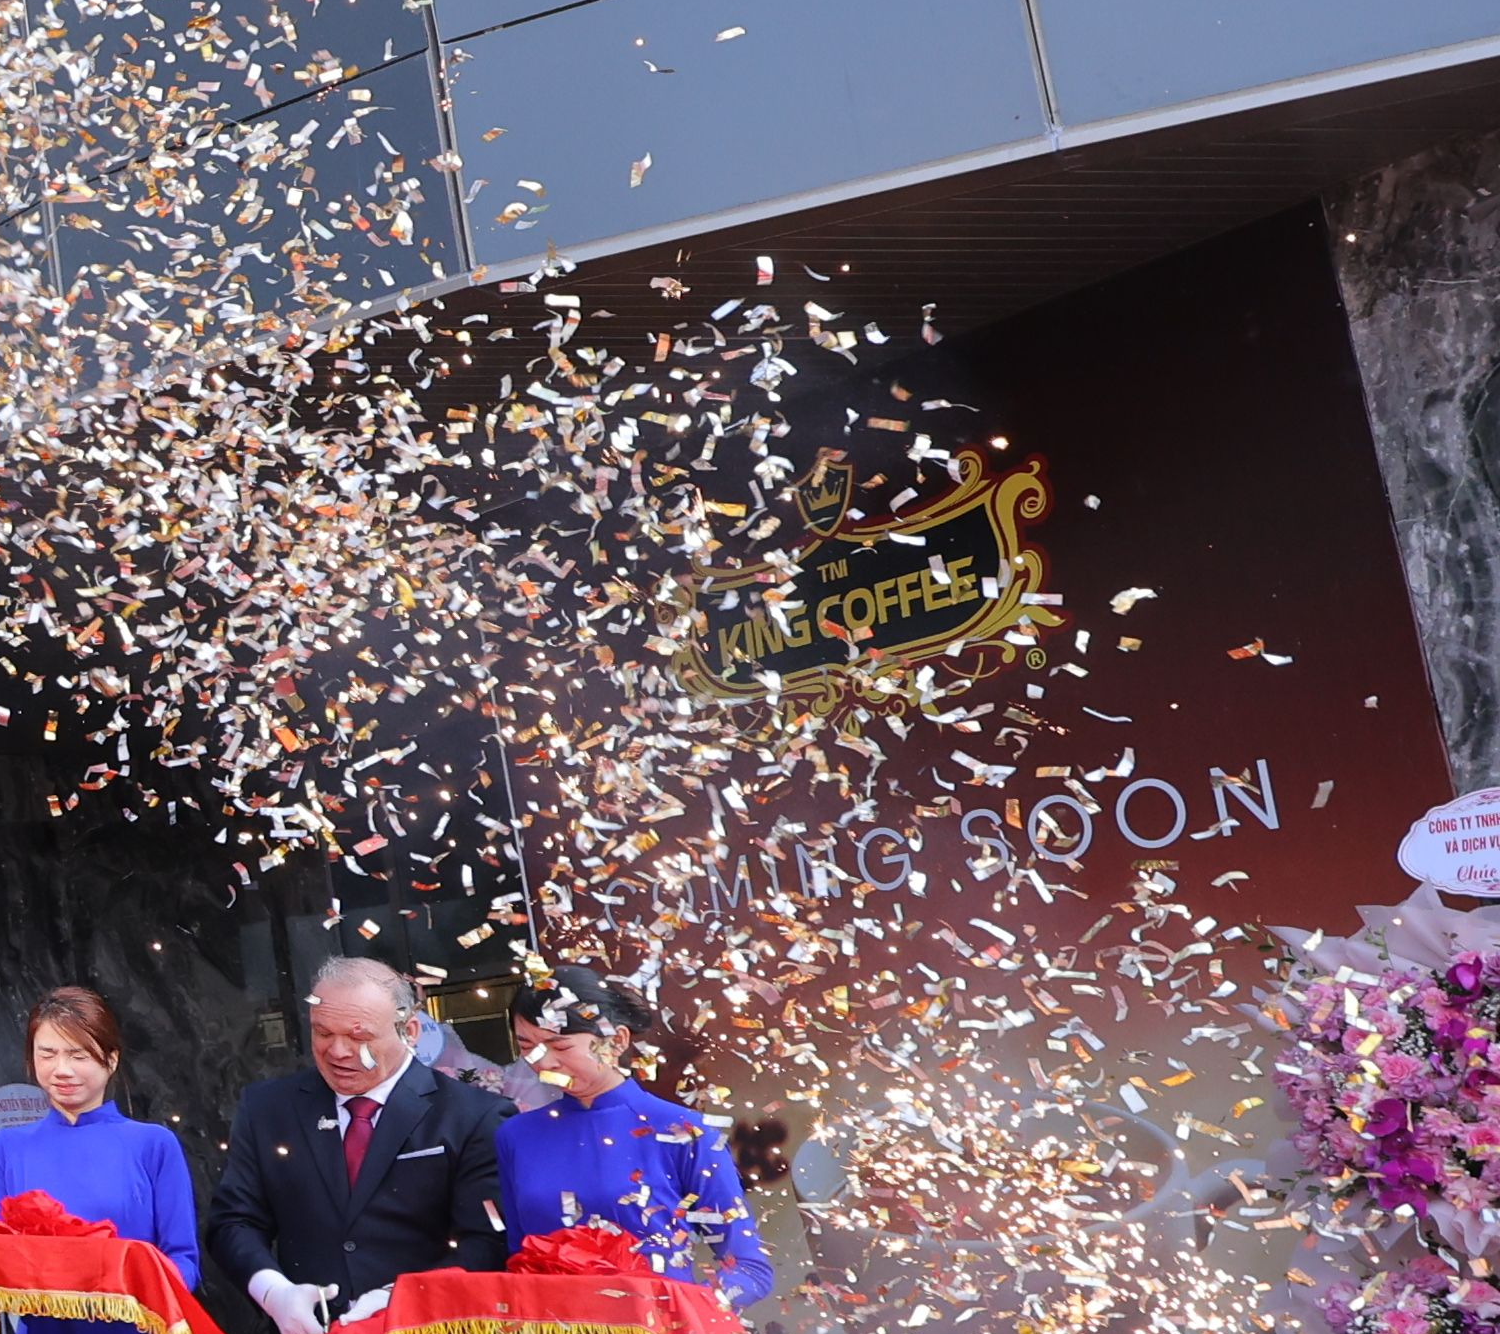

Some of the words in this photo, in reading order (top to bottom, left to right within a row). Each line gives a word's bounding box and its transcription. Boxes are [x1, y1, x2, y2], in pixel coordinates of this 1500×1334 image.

[816, 559, 849, 584] TNI
[717, 604, 813, 668] KING
[815, 555, 980, 639] COFFEE
[1428, 817, 1458, 834] CÔNG
[1461, 816, 1472, 830] TY
[604, 826, 913, 933] COMING
[960, 757, 1282, 873] SOON
[1445, 837, 1459, 854] VÀ
[1462, 836, 1487, 854] DỊCH
[1457, 864, 1497, 883] Chúc
